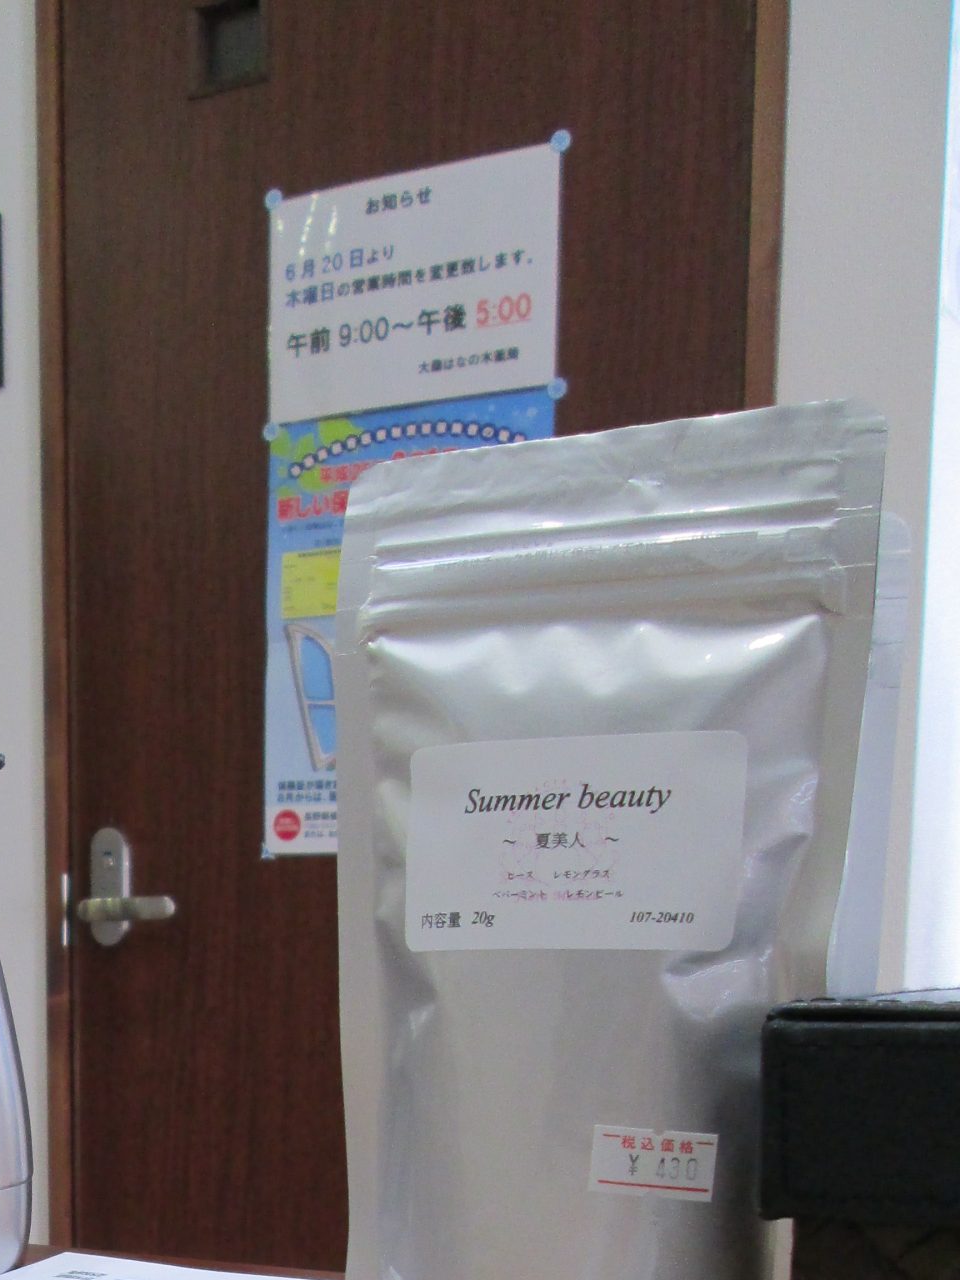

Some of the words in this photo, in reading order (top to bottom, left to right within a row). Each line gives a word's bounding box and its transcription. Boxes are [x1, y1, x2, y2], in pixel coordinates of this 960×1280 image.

[365, 186, 432, 214] お知らせ
[465, 788, 570, 814] Summer
[577, 784, 672, 814] beauty
[535, 832, 586, 849] 夏美人
[421, 911, 461, 929] 内容量
[471, 910, 495, 927] 20g
[629, 911, 694, 924] 107-20410
[621, 1135, 694, 1154] 税込価格
